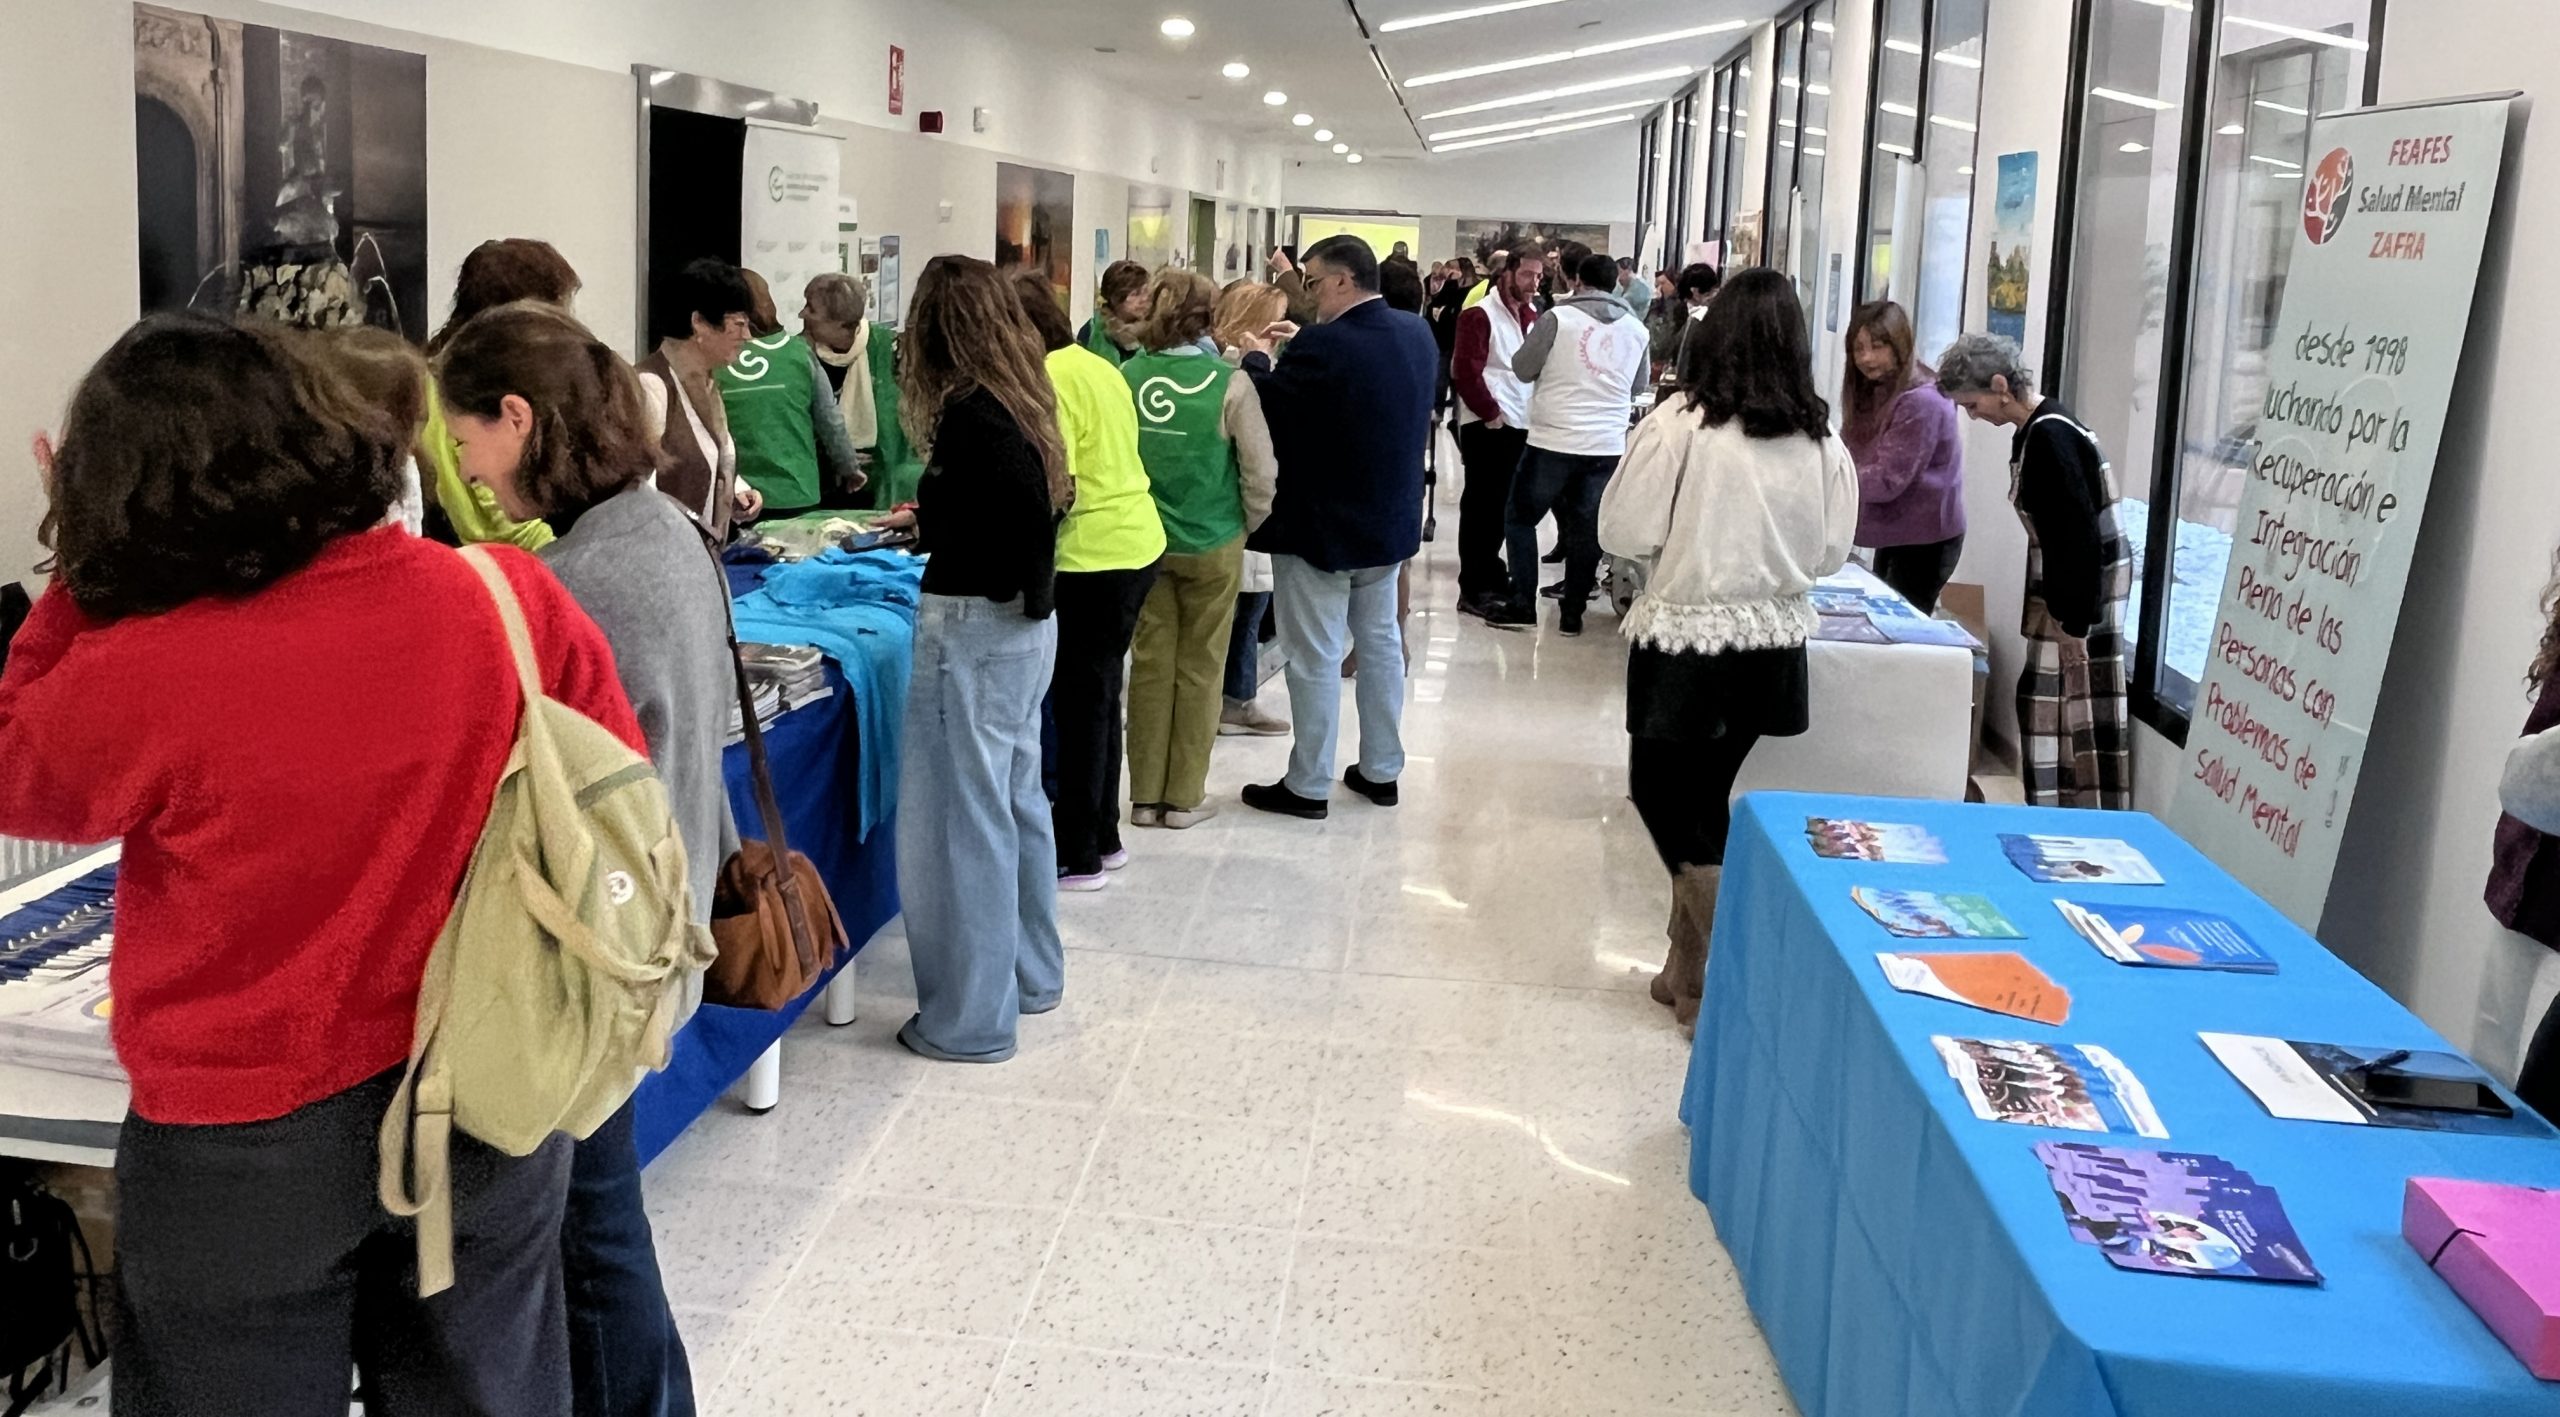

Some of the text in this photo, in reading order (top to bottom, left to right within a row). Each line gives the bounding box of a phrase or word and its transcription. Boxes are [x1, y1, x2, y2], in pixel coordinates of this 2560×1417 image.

[2388, 135, 2453, 166] FEAFES
[2358, 181, 2466, 213] Salud Mental
[2368, 231, 2426, 261] ZAFRA
[2296, 320, 2408, 375] desde 1998
[2263, 380, 2410, 453] luchando por la
[2377, 493, 2397, 523] e
[2251, 510, 2361, 588] Integración
[2237, 565, 2343, 655] Plena de las
[2217, 622, 2296, 701] Personas
[2205, 682, 2316, 790] Problemas de
[2194, 749, 2240, 804] Salud
[2239, 784, 2304, 857] Mental
